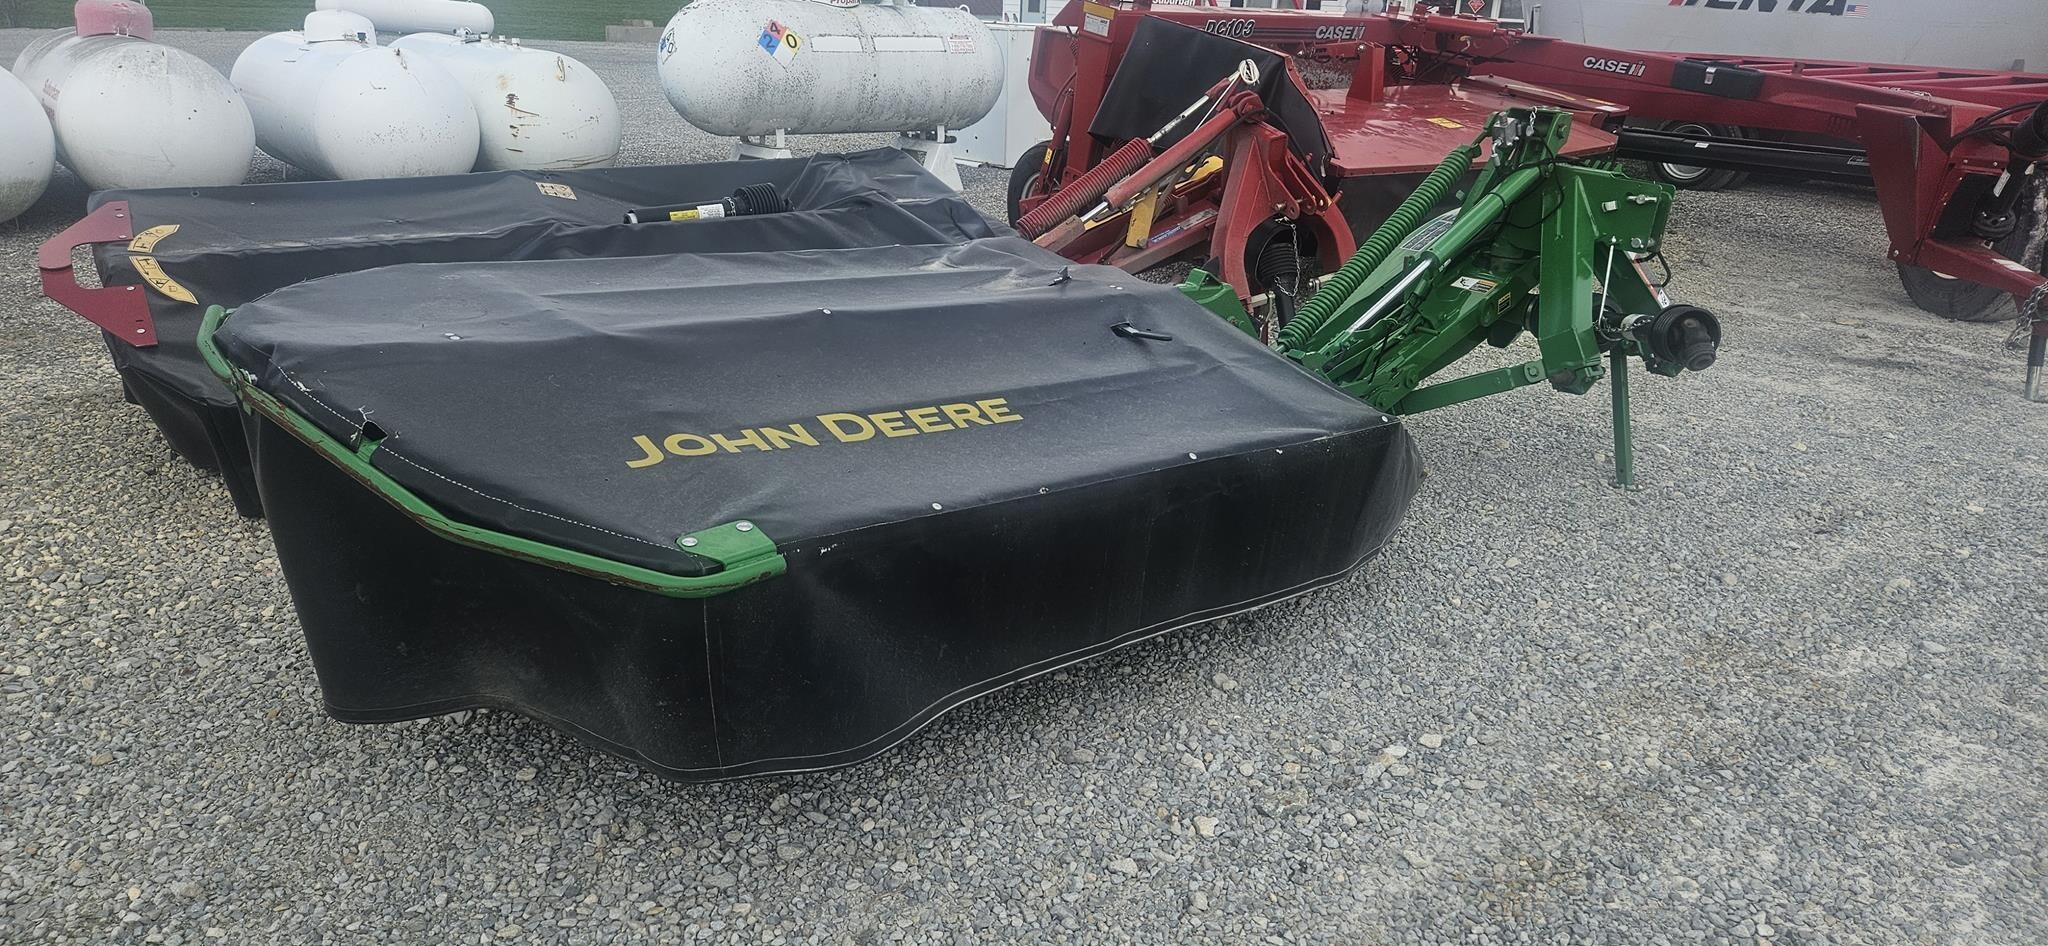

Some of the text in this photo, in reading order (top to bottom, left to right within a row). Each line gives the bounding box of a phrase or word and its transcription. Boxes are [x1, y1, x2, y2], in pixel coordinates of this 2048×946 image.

[769, 21, 781, 35] 4
[1205, 18, 1256, 38] DC103
[1315, 25, 1354, 39] CASE
[763, 33, 798, 49] 2 0
[1583, 56, 1629, 75] CASE
[626, 398, 1024, 468] JOHN DEERE
